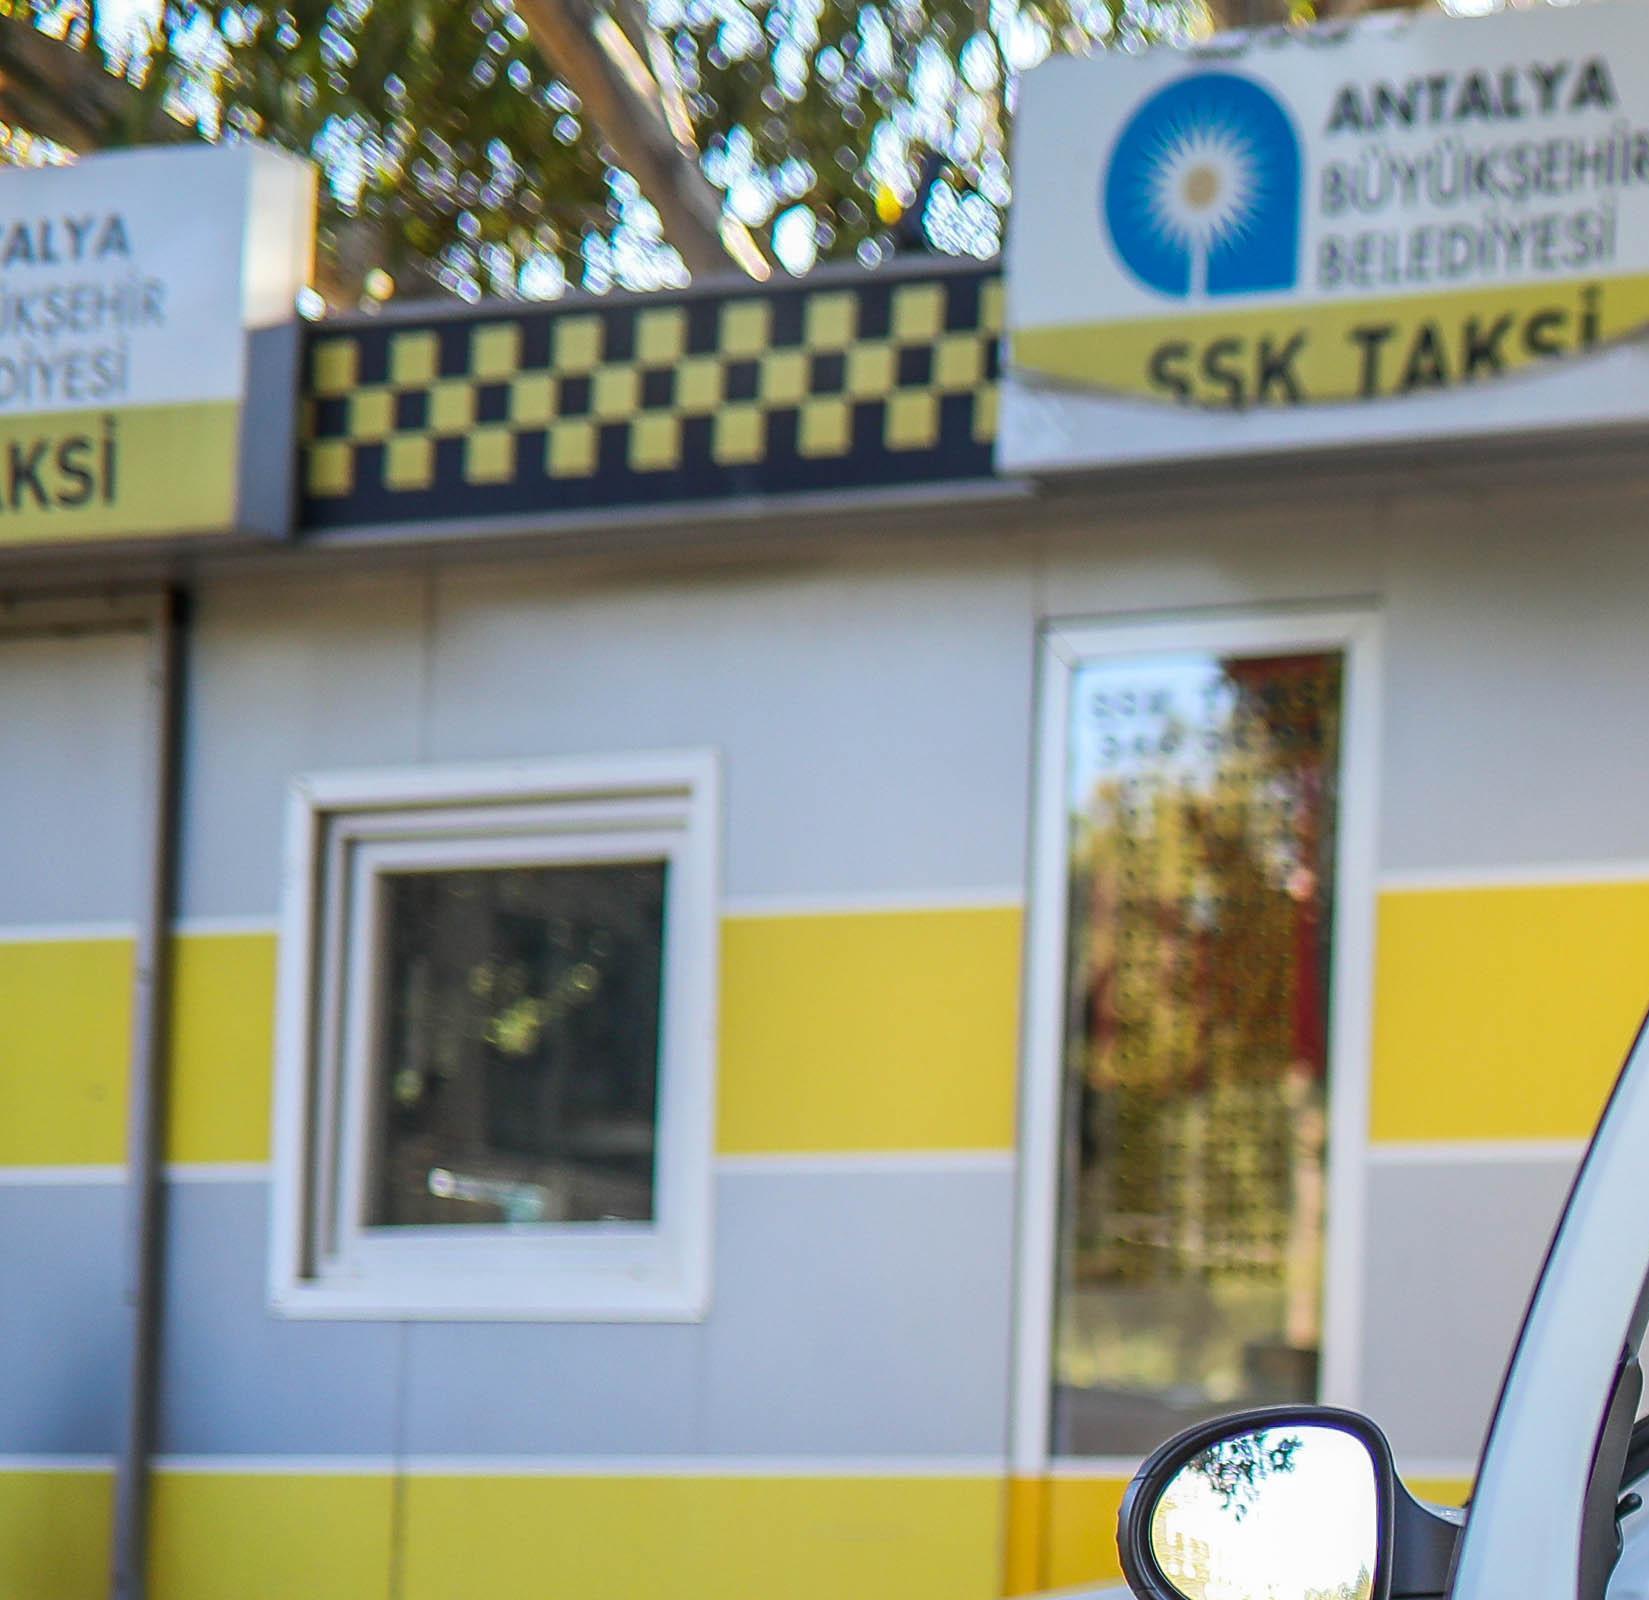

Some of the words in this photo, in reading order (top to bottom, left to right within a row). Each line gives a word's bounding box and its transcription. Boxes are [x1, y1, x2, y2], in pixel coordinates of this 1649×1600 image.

[1326, 54, 1620, 134] ANTALYA
[0, 212, 130, 267] ALYA
[1319, 197, 1616, 288] BELEDİYESİ
[1147, 328, 1307, 412] SSK
[1349, 284, 1604, 402] TAKSİ
[0, 412, 117, 514] KSİ
